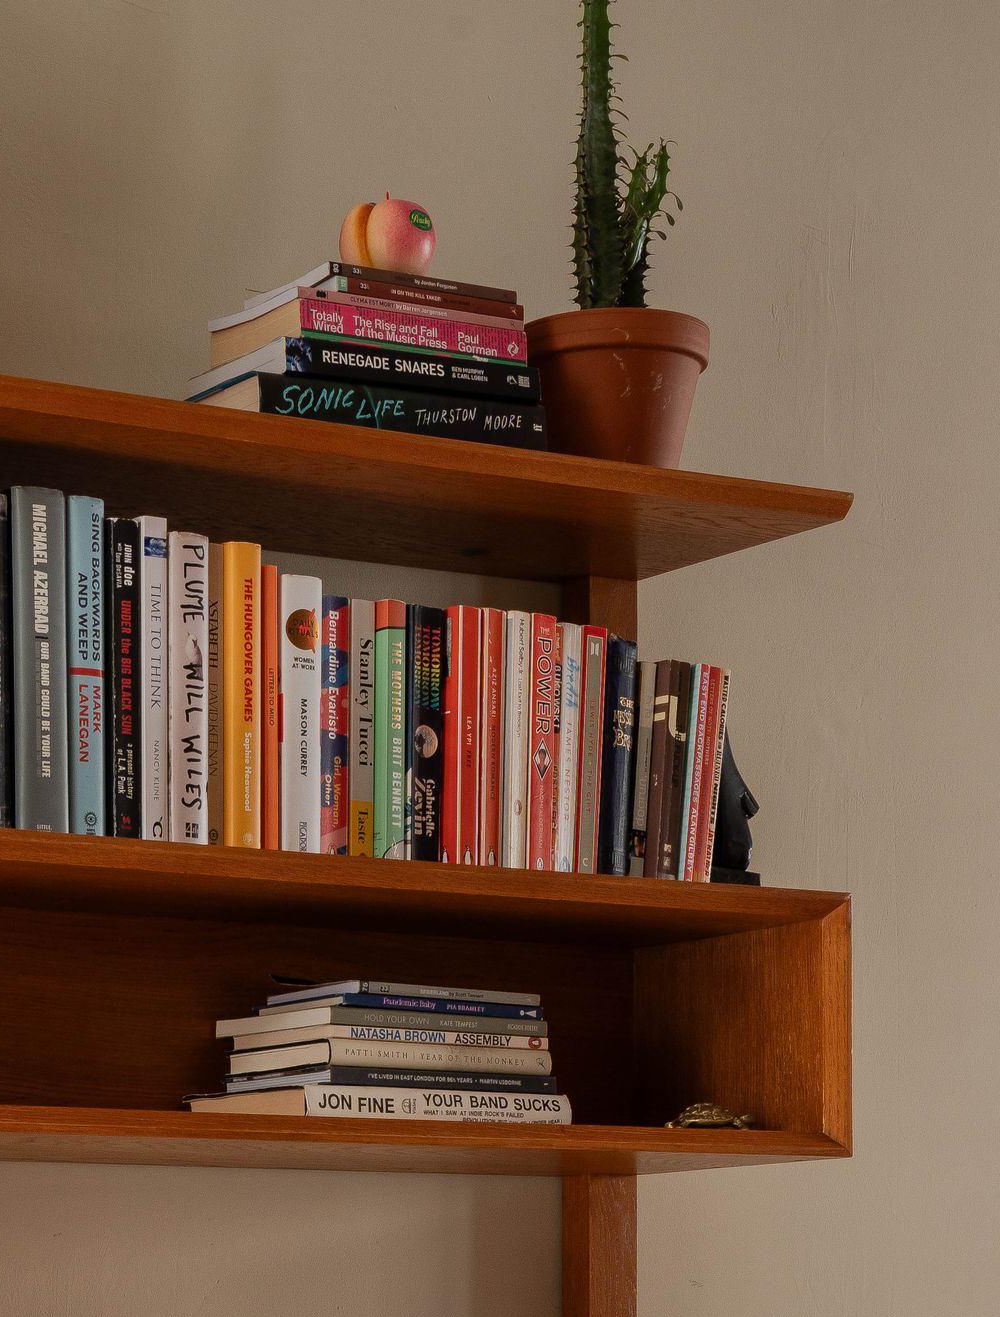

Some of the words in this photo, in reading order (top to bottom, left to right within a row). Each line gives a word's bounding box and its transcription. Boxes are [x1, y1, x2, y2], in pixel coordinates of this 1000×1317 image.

[310, 309, 344, 327] Totally
[313, 319, 344, 334] Wired
[352, 315, 372, 328] The
[375, 319, 396, 332] Rise
[399, 322, 417, 333] and
[420, 325, 438, 338] Fall
[355, 329, 365, 338] of
[367, 329, 384, 340] the
[386, 332, 416, 346] Music
[419, 336, 447, 350] Press
[457, 332, 479, 345] Paul
[457, 341, 498, 357] Gorman
[322, 349, 390, 371] RENEGADE
[395, 359, 445, 377] SNARES
[275, 385, 353, 414] SONIC
[414, 407, 477, 427] THURSTON
[484, 415, 522, 432] MOORE
[32, 504, 47, 566] MICHAEL
[91, 512, 100, 552] SING
[124, 544, 132, 564] JOHN
[78, 572, 88, 608] AND
[124, 567, 135, 586] doe
[180, 544, 205, 623] PLUME
[244, 578, 253, 602] THE
[34, 570, 49, 634] AZERRAD
[91, 558, 101, 661] BACKWARDS
[151, 584, 162, 622] TIME
[78, 613, 88, 661] WEEP
[151, 628, 161, 649] TO
[243, 605, 253, 670] HUNGOVER
[328, 610, 339, 683] Bernardine
[294, 656, 314, 664] WOMEN
[391, 642, 402, 665] THE
[151, 655, 162, 710] THINK
[355, 638, 373, 710] Stanley
[536, 636, 553, 735] POWER
[701, 671, 709, 697] EAST
[183, 663, 205, 723] WILL
[243, 672, 253, 722] GAMES
[269, 695, 275, 705] TO
[391, 670, 402, 730] MOTHERS
[79, 683, 89, 763] LANEGAN
[92, 685, 101, 733] MARK
[328, 687, 339, 740] Evaristo
[358, 713, 373, 767] Tucci
[392, 737, 402, 767] BRIT
[181, 735, 203, 810] WILES
[392, 772, 402, 828] BENNETT
[425, 779, 436, 837] Gabrielle
[357, 808, 369, 844] Taste
[364, 1013, 384, 1023] HOLD
[387, 1015, 406, 1024] YOUR
[409, 1016, 430, 1025] OWN
[454, 1021, 478, 1029] TEMPEST
[350, 1027, 400, 1041] NATASHA
[405, 1029, 446, 1043] BROWN
[454, 1033, 511, 1047] ASSEMBLY
[345, 1048, 373, 1056] PATTI
[377, 1050, 408, 1059] SMITH
[319, 1093, 352, 1110] JON
[359, 1097, 395, 1113] FINE
[422, 1093, 463, 1107] YOUR
[470, 1095, 508, 1110] BAND
[513, 1097, 561, 1112] SUCKS
